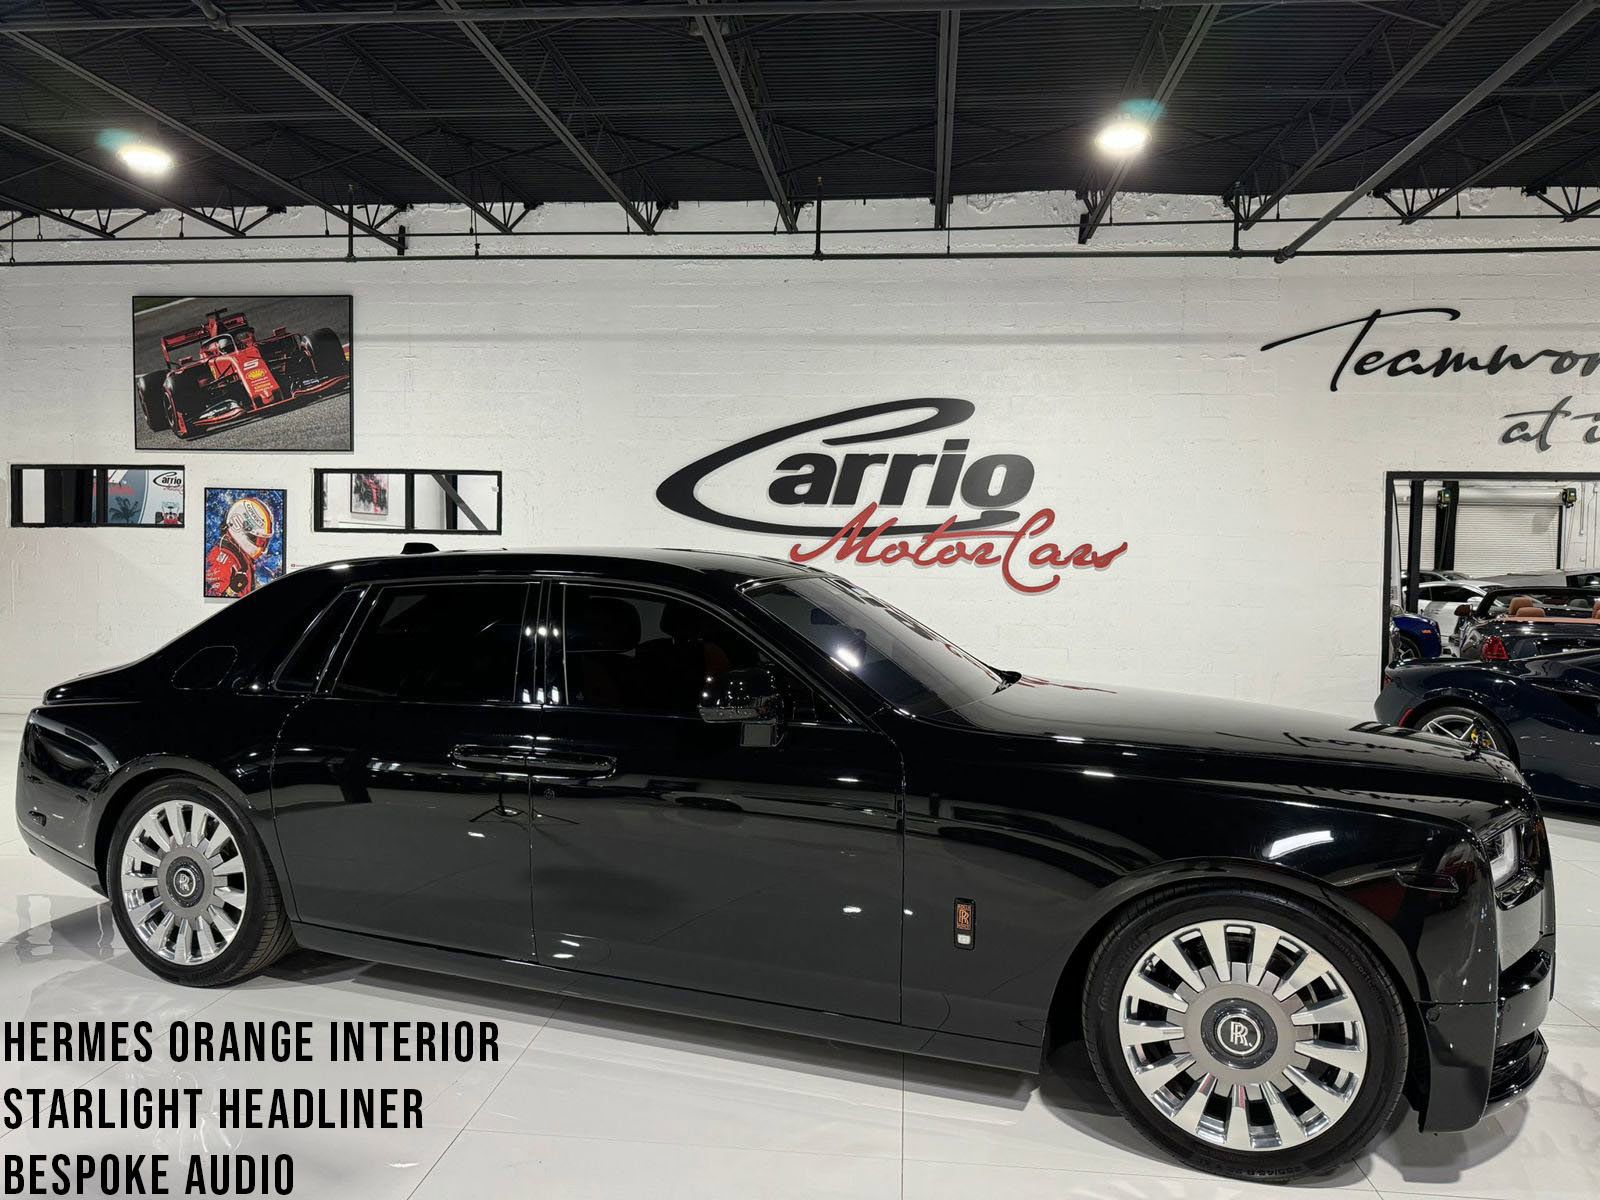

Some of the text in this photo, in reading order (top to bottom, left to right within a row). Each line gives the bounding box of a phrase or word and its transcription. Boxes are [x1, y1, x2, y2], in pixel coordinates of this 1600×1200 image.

[1502, 395, 1573, 452] at
[153, 471, 182, 488] Carrio
[656, 397, 1035, 537] Carrio
